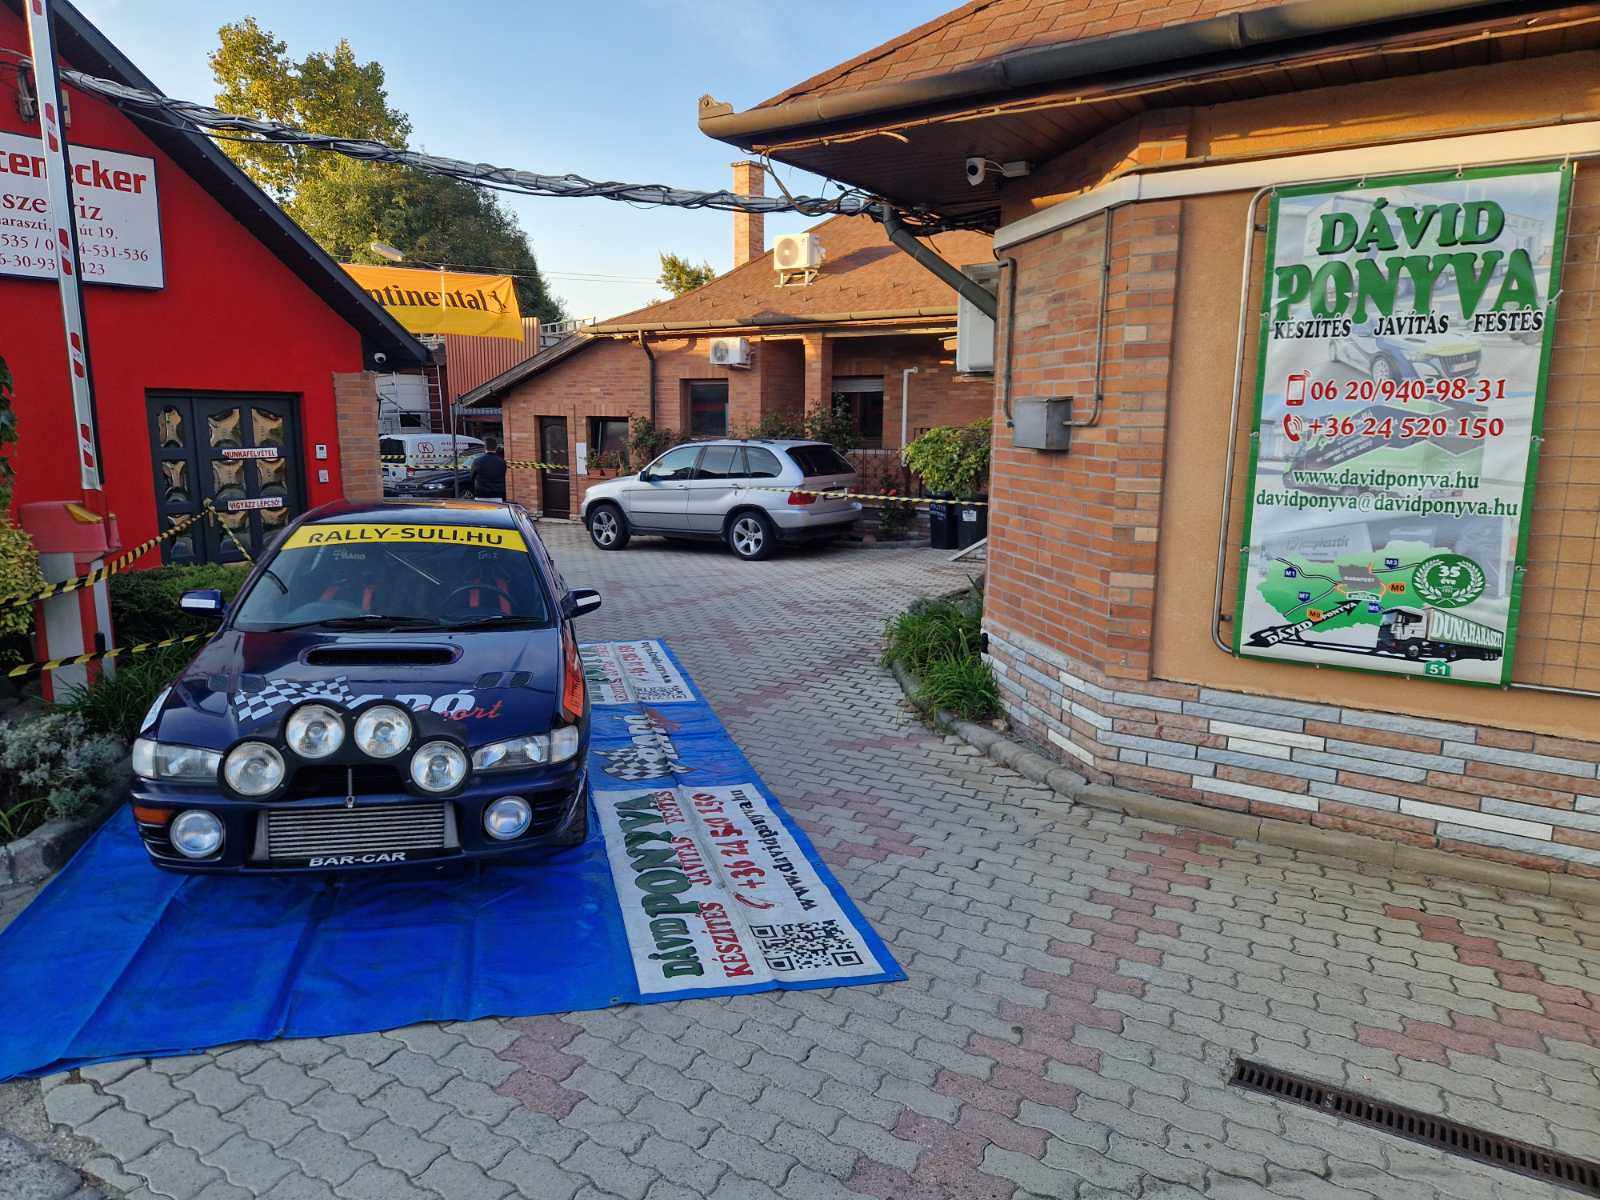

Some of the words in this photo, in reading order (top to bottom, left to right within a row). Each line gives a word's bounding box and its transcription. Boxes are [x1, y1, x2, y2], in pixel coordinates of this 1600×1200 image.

[0, 217, 52, 232] araszti,
[99, 226, 118, 240] 19.
[1316, 196, 1505, 255] DÁVID
[366, 285, 489, 312] ntinental
[1275, 248, 1540, 324] PONYVA
[1274, 315, 1351, 340] KÉSZÍTÉS
[1373, 310, 1449, 336] JAVÍTÁS
[1473, 306, 1543, 333] FESTÉS
[1310, 381, 1338, 401] 06
[1344, 378, 1507, 404] 20/940-98-31
[1309, 416, 1355, 438] +36
[1362, 417, 1393, 440] 24
[1400, 417, 1447, 440] 520
[1458, 417, 1505, 439] 150
[1293, 468, 1480, 490] www.davidponyva.hu
[1256, 489, 1519, 518] davidponyva@davidponyva.hu
[308, 527, 504, 545] RALLY-SULI.HU
[1429, 664, 1447, 676] 51
[309, 851, 406, 867] BAR-CAR
[612, 793, 703, 918] PONYVA
[723, 860, 767, 889] +36
[648, 917, 705, 978] DÁVID
[696, 902, 754, 978] KÉSZÍTÉS
